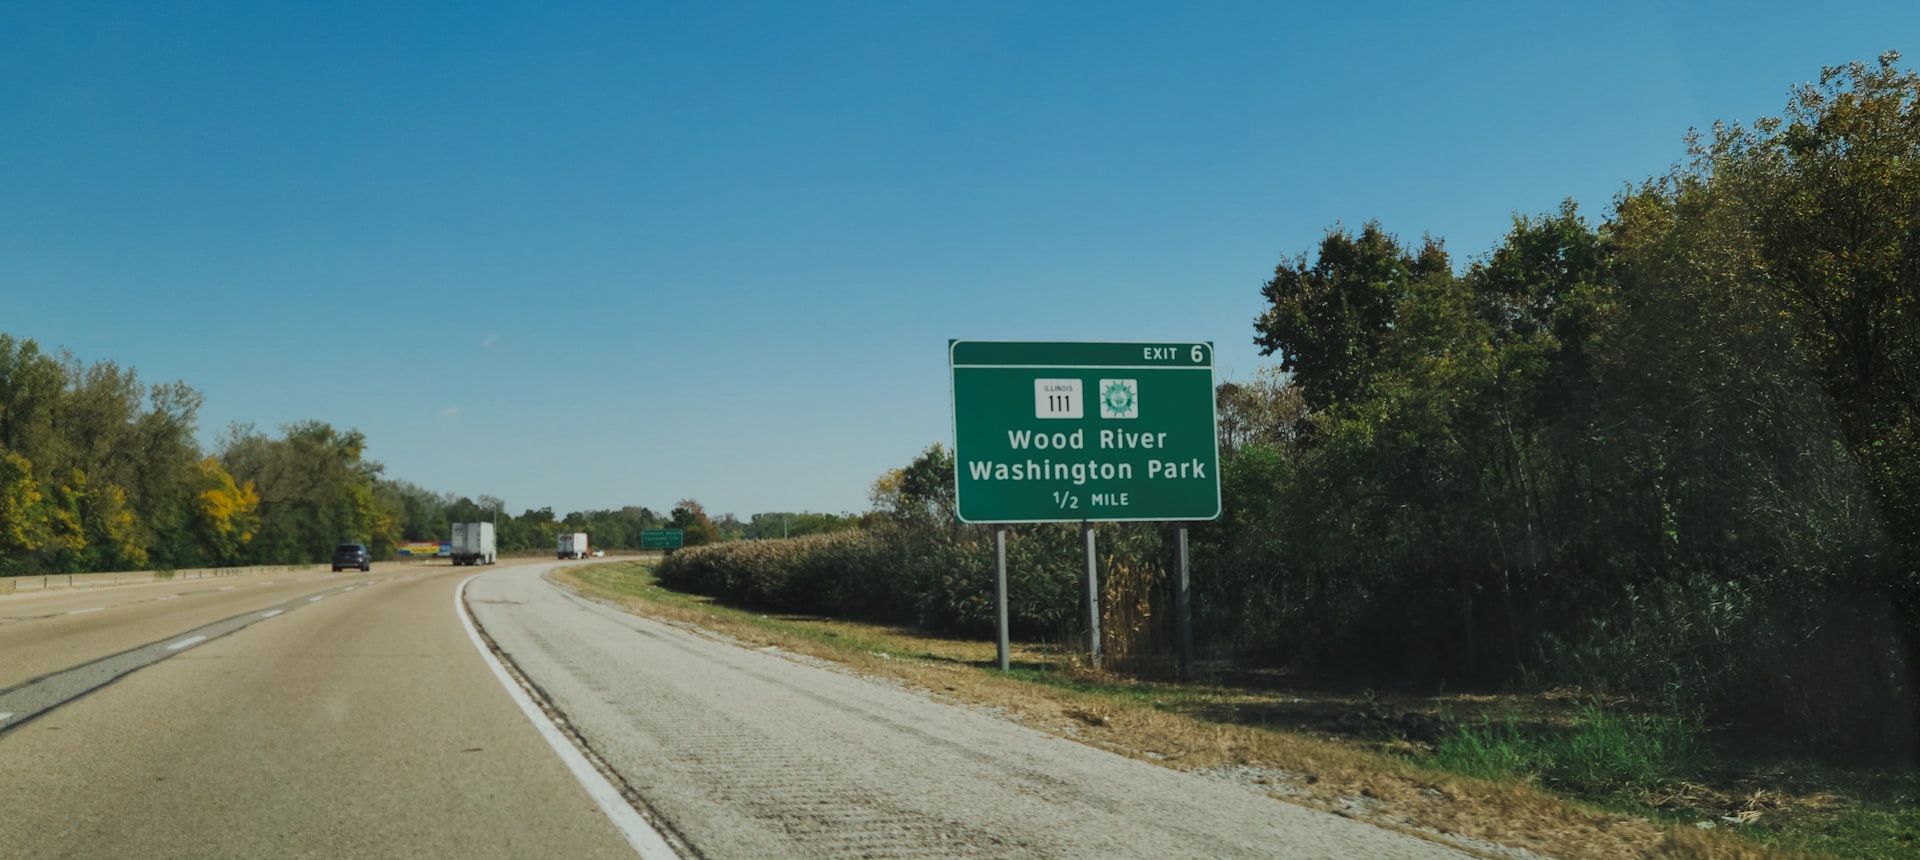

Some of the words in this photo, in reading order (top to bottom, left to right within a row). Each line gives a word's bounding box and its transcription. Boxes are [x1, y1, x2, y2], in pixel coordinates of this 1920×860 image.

[1144, 347, 1177, 360] EXIT
[1191, 345, 1204, 362] 6
[1048, 395, 1070, 412] 111
[1008, 429, 1084, 449] Wood
[1100, 429, 1167, 449] River
[969, 459, 1132, 485] Washington
[1148, 458, 1206, 479] Park
[1091, 493, 1129, 506] MILE
